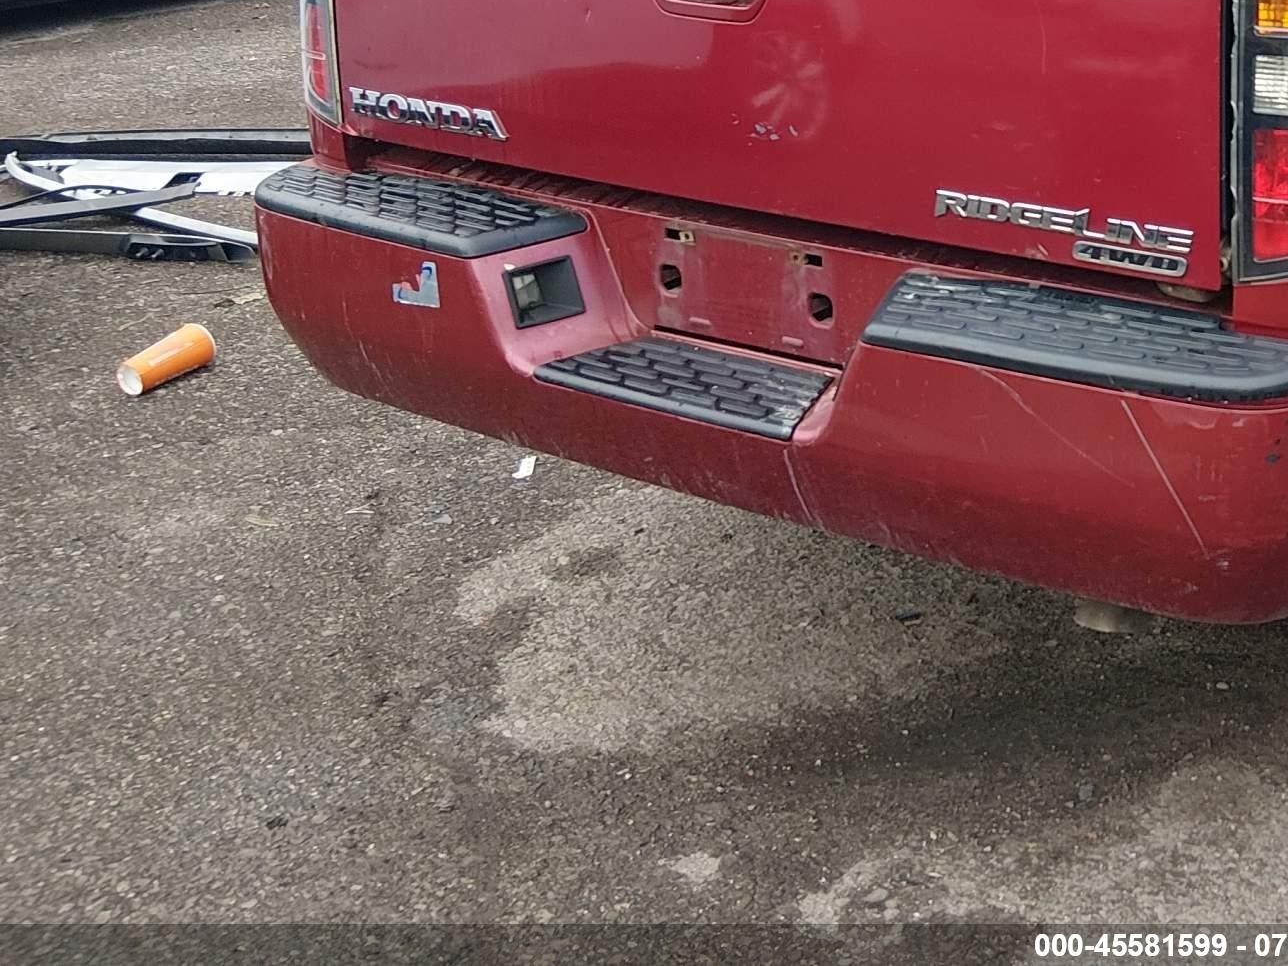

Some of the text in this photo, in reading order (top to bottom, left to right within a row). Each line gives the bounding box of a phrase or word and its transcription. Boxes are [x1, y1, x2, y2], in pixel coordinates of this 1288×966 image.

[349, 86, 510, 142] HONDA
[934, 188, 1195, 254] RIDGELINE
[1076, 243, 1181, 273] 4WD
